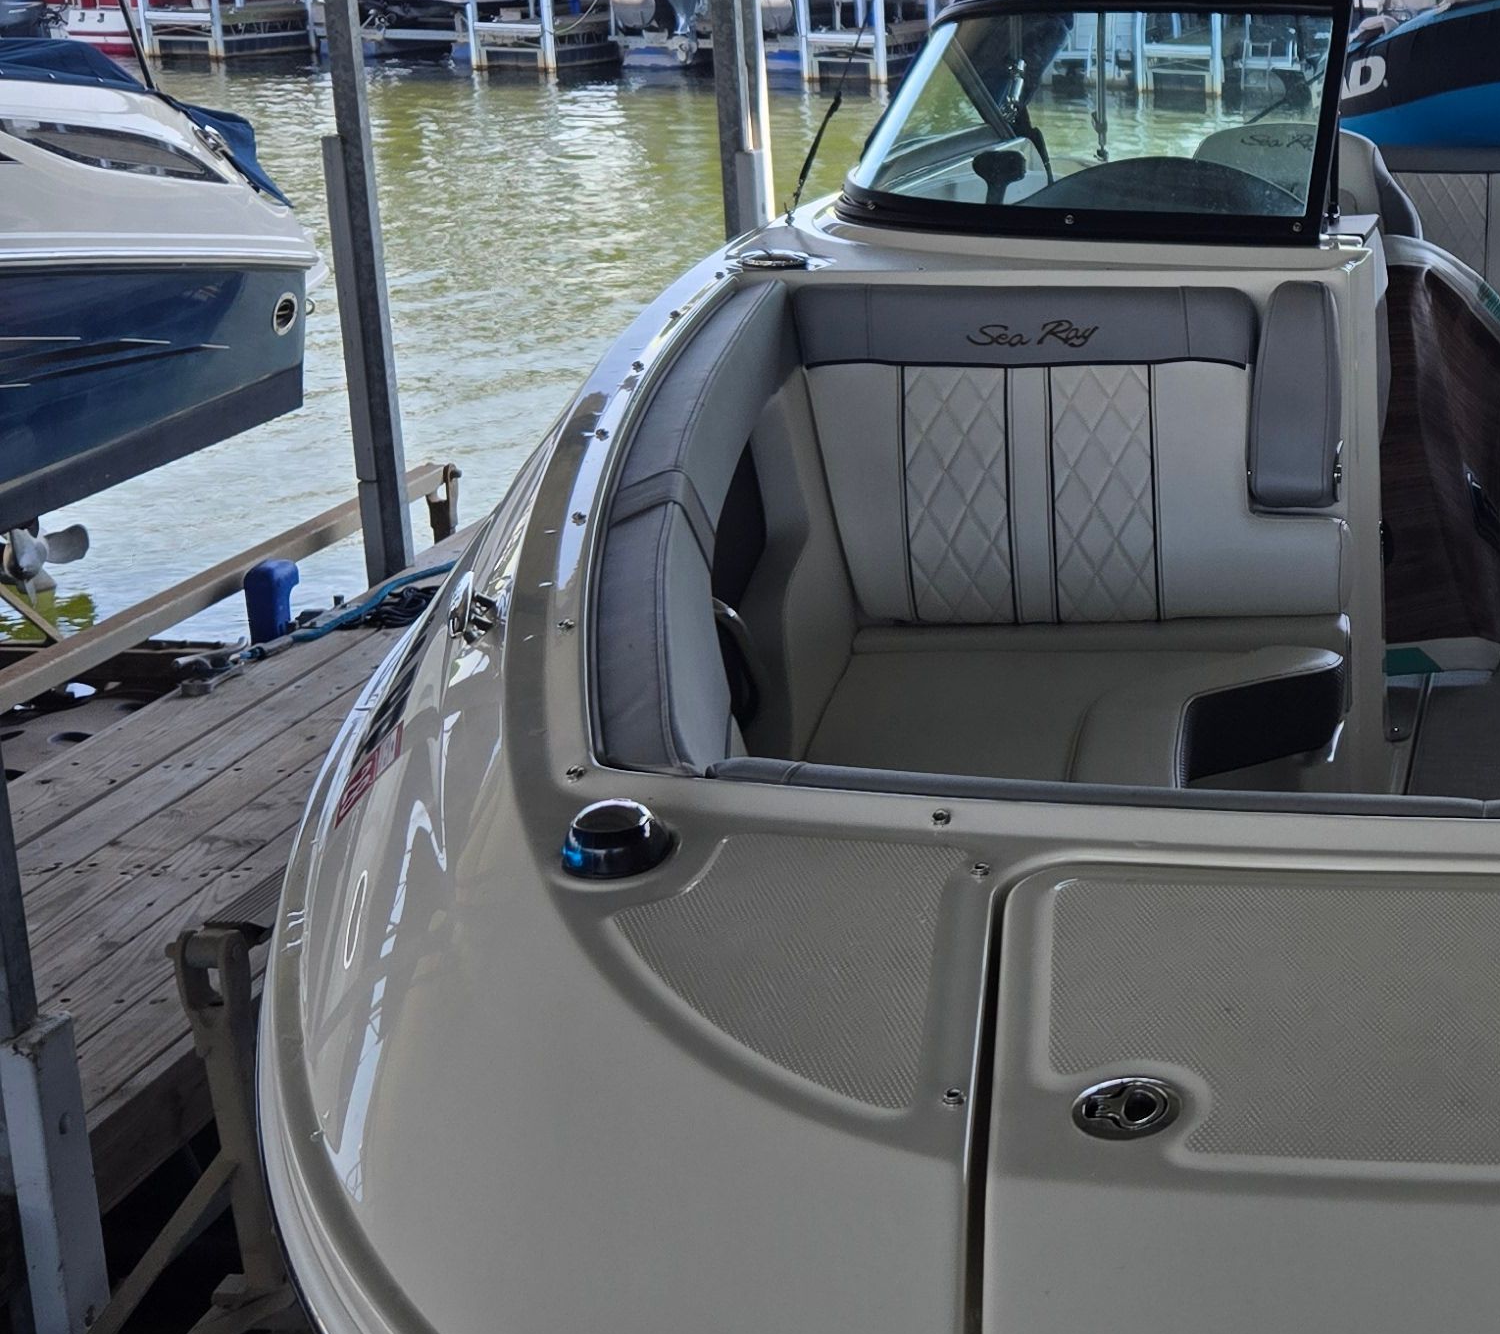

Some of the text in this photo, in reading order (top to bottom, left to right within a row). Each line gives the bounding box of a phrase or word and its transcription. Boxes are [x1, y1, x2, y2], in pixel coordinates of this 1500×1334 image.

[1240, 134, 1283, 148] Sea
[966, 319, 1099, 348] Sea Ray
